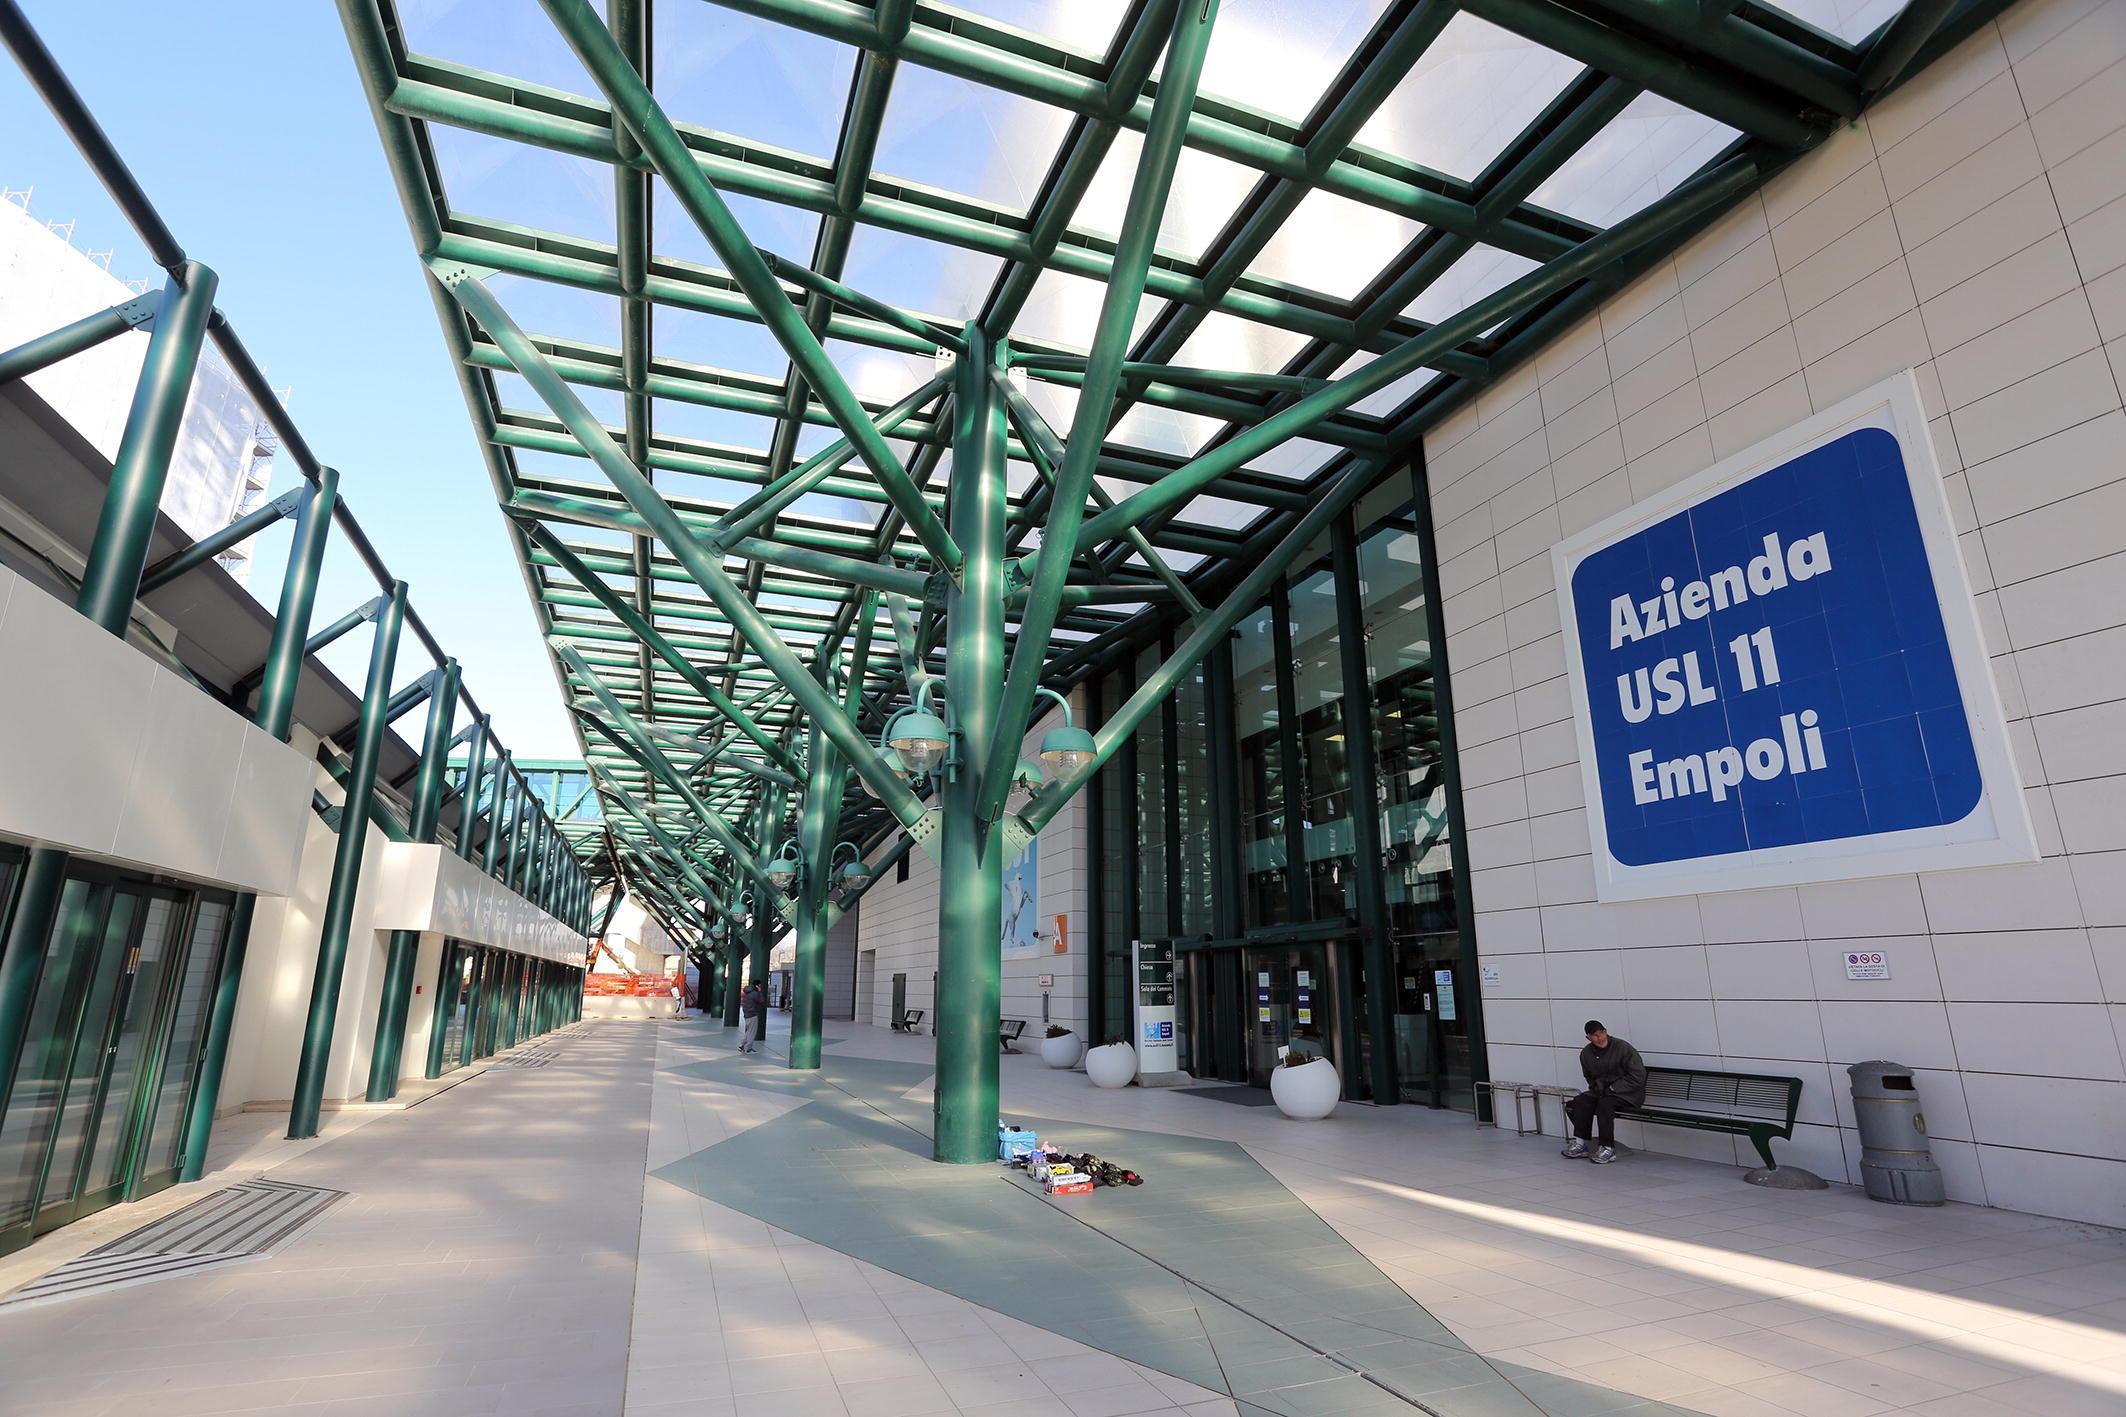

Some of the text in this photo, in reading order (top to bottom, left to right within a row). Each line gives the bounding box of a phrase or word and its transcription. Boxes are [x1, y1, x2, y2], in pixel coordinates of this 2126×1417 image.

[1610, 531, 1832, 650] Azienda
[1617, 626, 1781, 724] USL 11
[1628, 709, 1827, 805] Empoli
